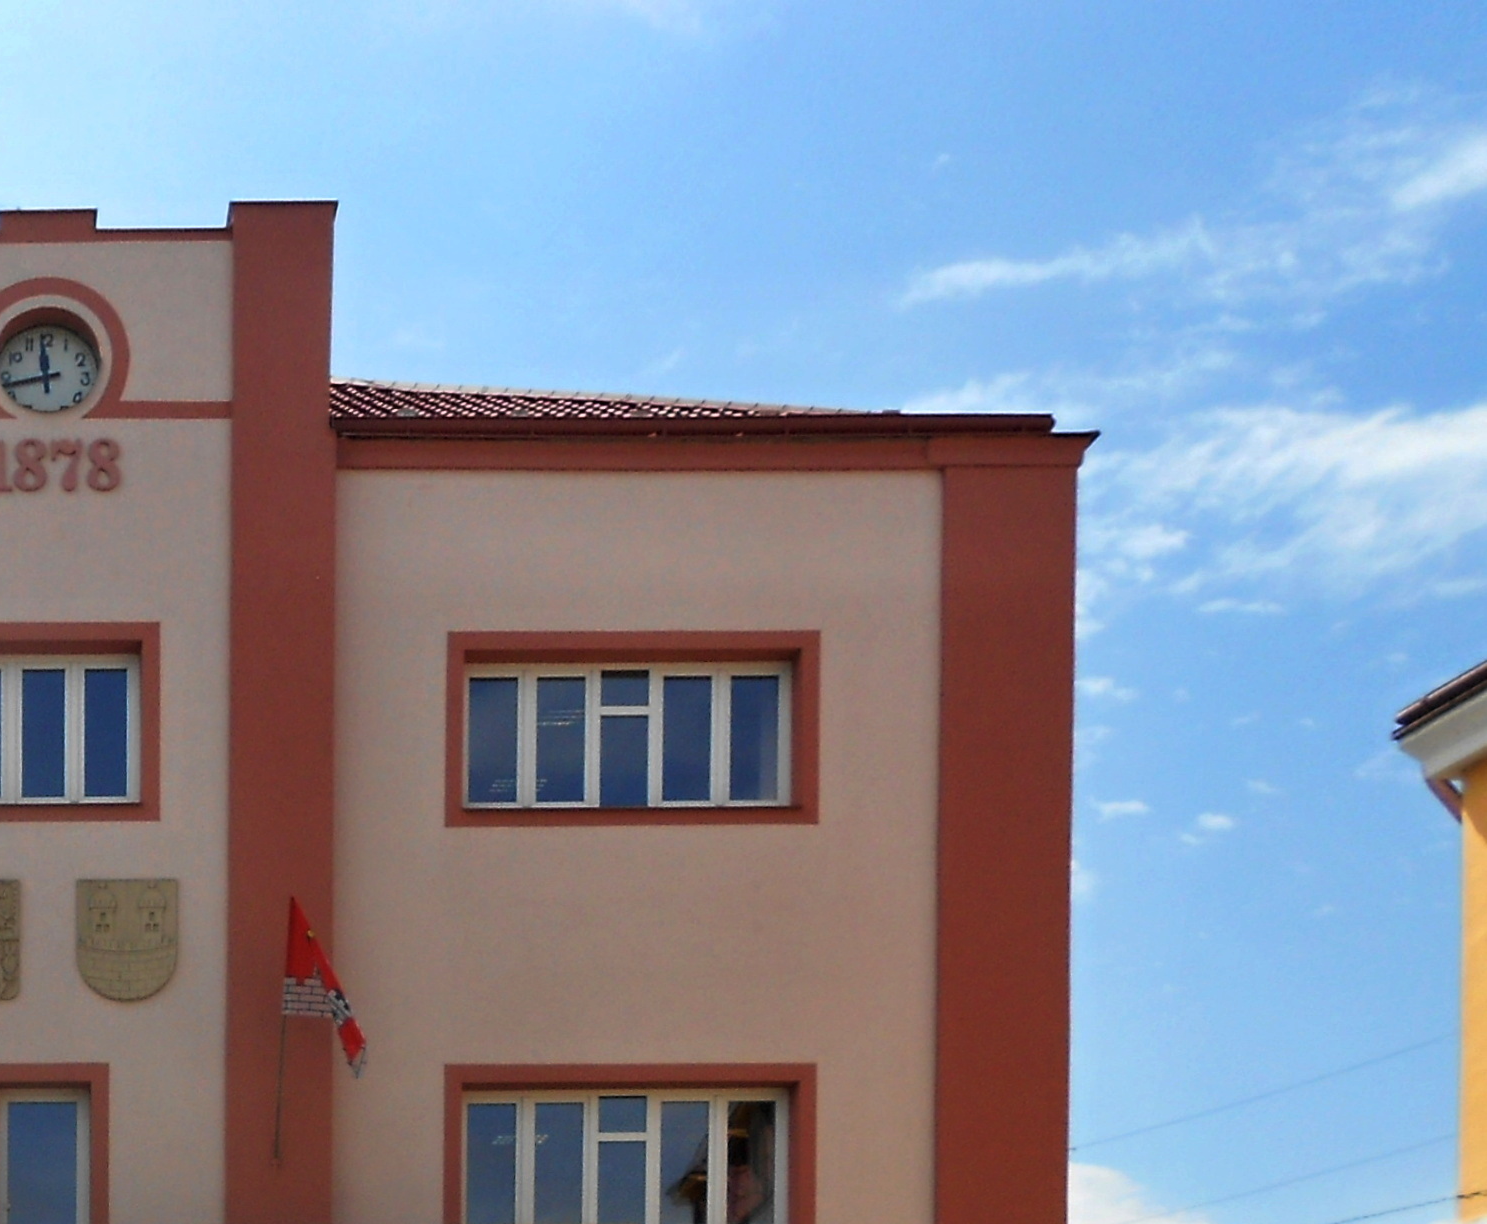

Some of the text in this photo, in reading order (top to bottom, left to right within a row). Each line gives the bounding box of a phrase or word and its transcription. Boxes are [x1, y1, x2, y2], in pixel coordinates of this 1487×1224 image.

[9, 351, 22, 366] 10
[74, 352, 86, 367] 2
[80, 371, 91, 387] 3
